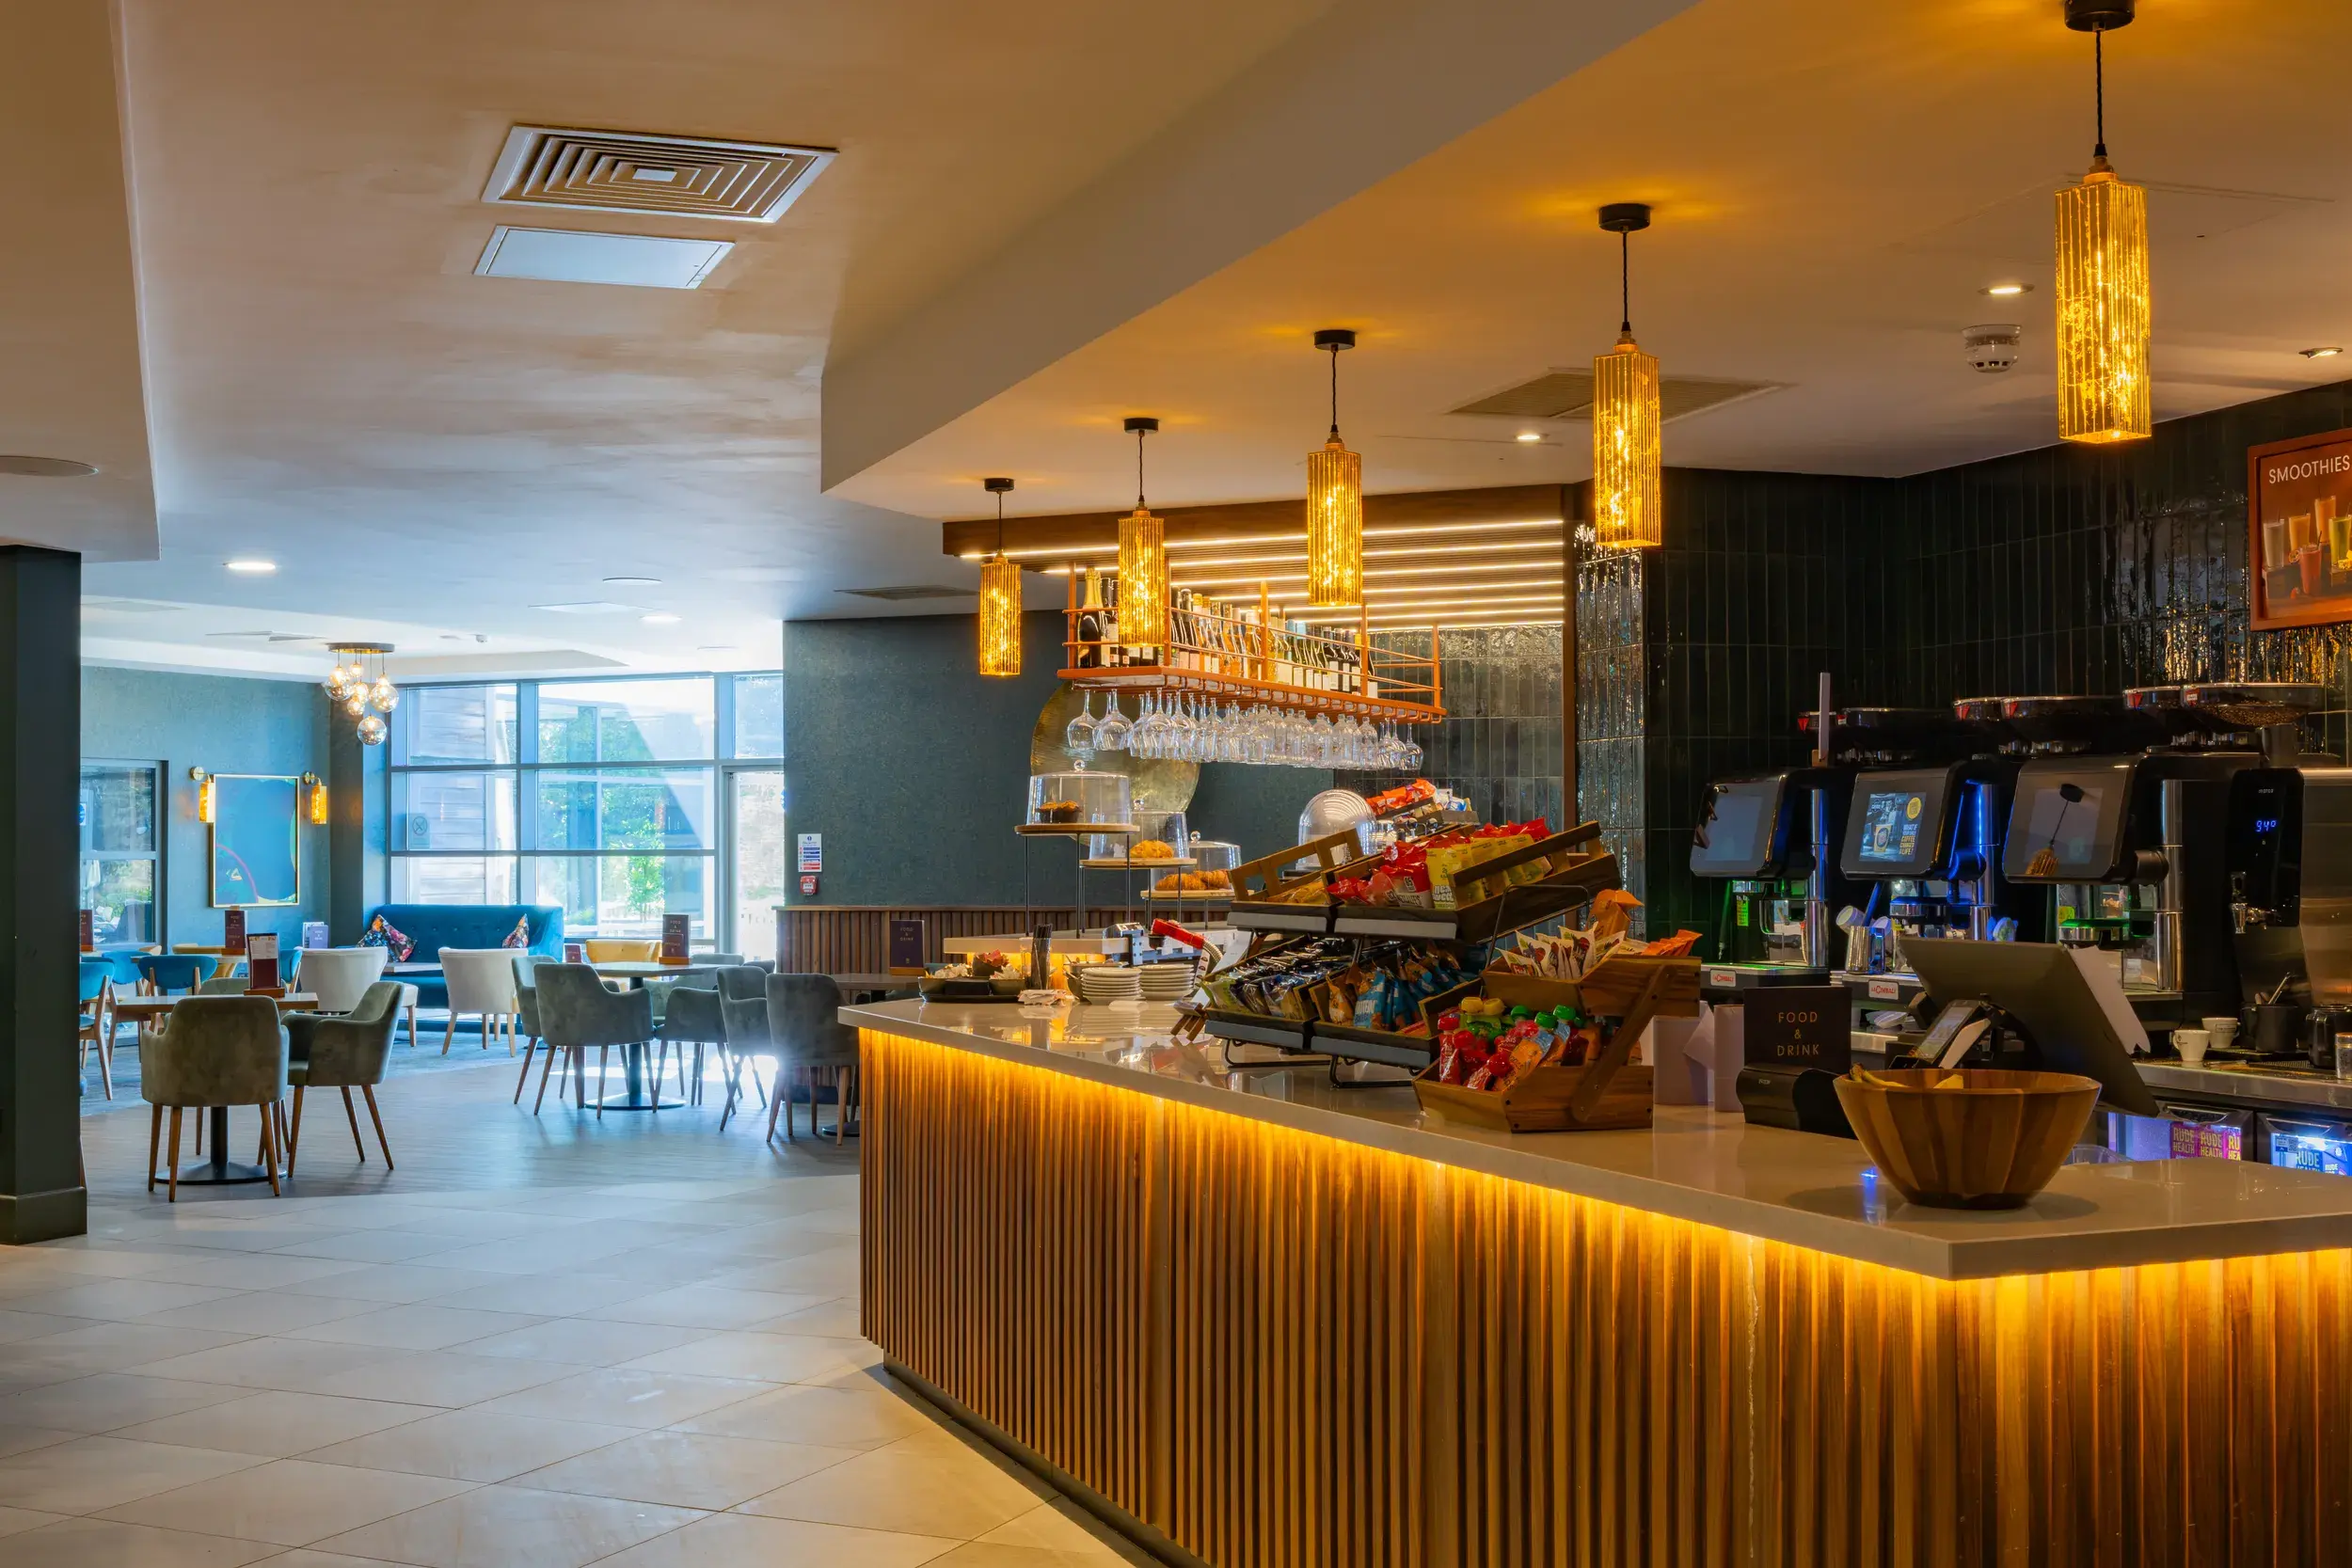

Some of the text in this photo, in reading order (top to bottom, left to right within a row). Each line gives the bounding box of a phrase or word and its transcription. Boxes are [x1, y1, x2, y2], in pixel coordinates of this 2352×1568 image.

[2268, 454, 2350, 484] SMOOTHIES
[1778, 1011, 1818, 1023] FOOD
[1794, 1028, 1802, 1039] &
[1776, 1044, 1820, 1056] DRINK
[2173, 1127, 2195, 1144] RUDE
[2200, 1132, 2222, 1148] RUDE
[2172, 1141, 2195, 1154] HEALTH
[2228, 1135, 2241, 1150] RU
[2200, 1146, 2222, 1158] HEALTH
[2228, 1150, 2241, 1161] HEA
[2296, 1150, 2320, 1167] RUDE
